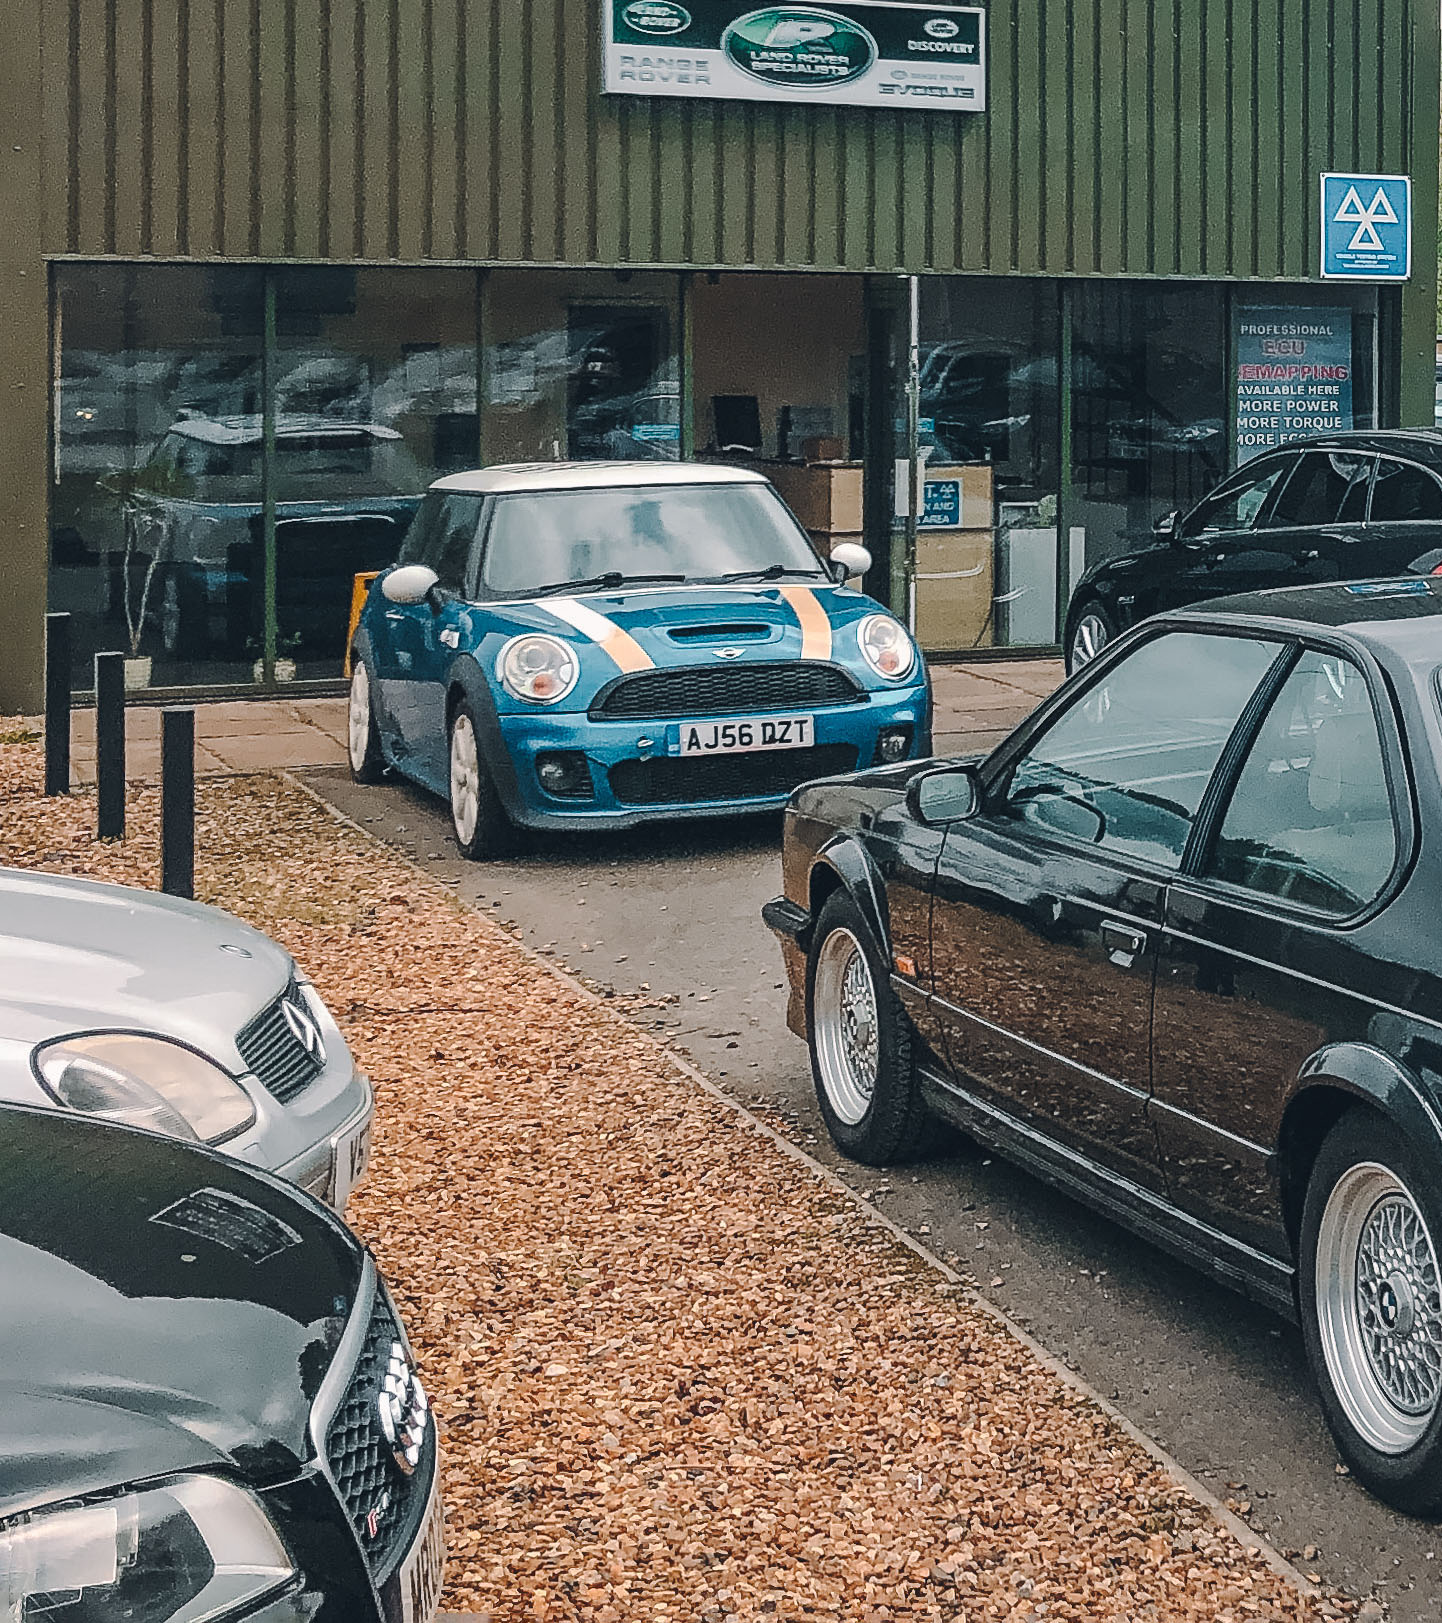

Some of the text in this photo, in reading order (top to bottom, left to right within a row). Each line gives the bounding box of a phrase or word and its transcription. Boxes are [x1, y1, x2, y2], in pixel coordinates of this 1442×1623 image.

[908, 40, 974, 54] DISCOVERY
[620, 55, 709, 71] RANGE
[750, 51, 850, 65] LAND ROVER
[751, 61, 850, 76] SPECIALISTS
[620, 71, 712, 85] ROVER
[1240, 325, 1334, 336] PROFESSIONAL
[1262, 339, 1306, 356] ECU
[1237, 385, 1340, 395] AVAILABLE HERE
[1239, 400, 1339, 412] MORE POWER
[1236, 416, 1342, 431] MORE TORQUE
[686, 723, 754, 751] AJ56
